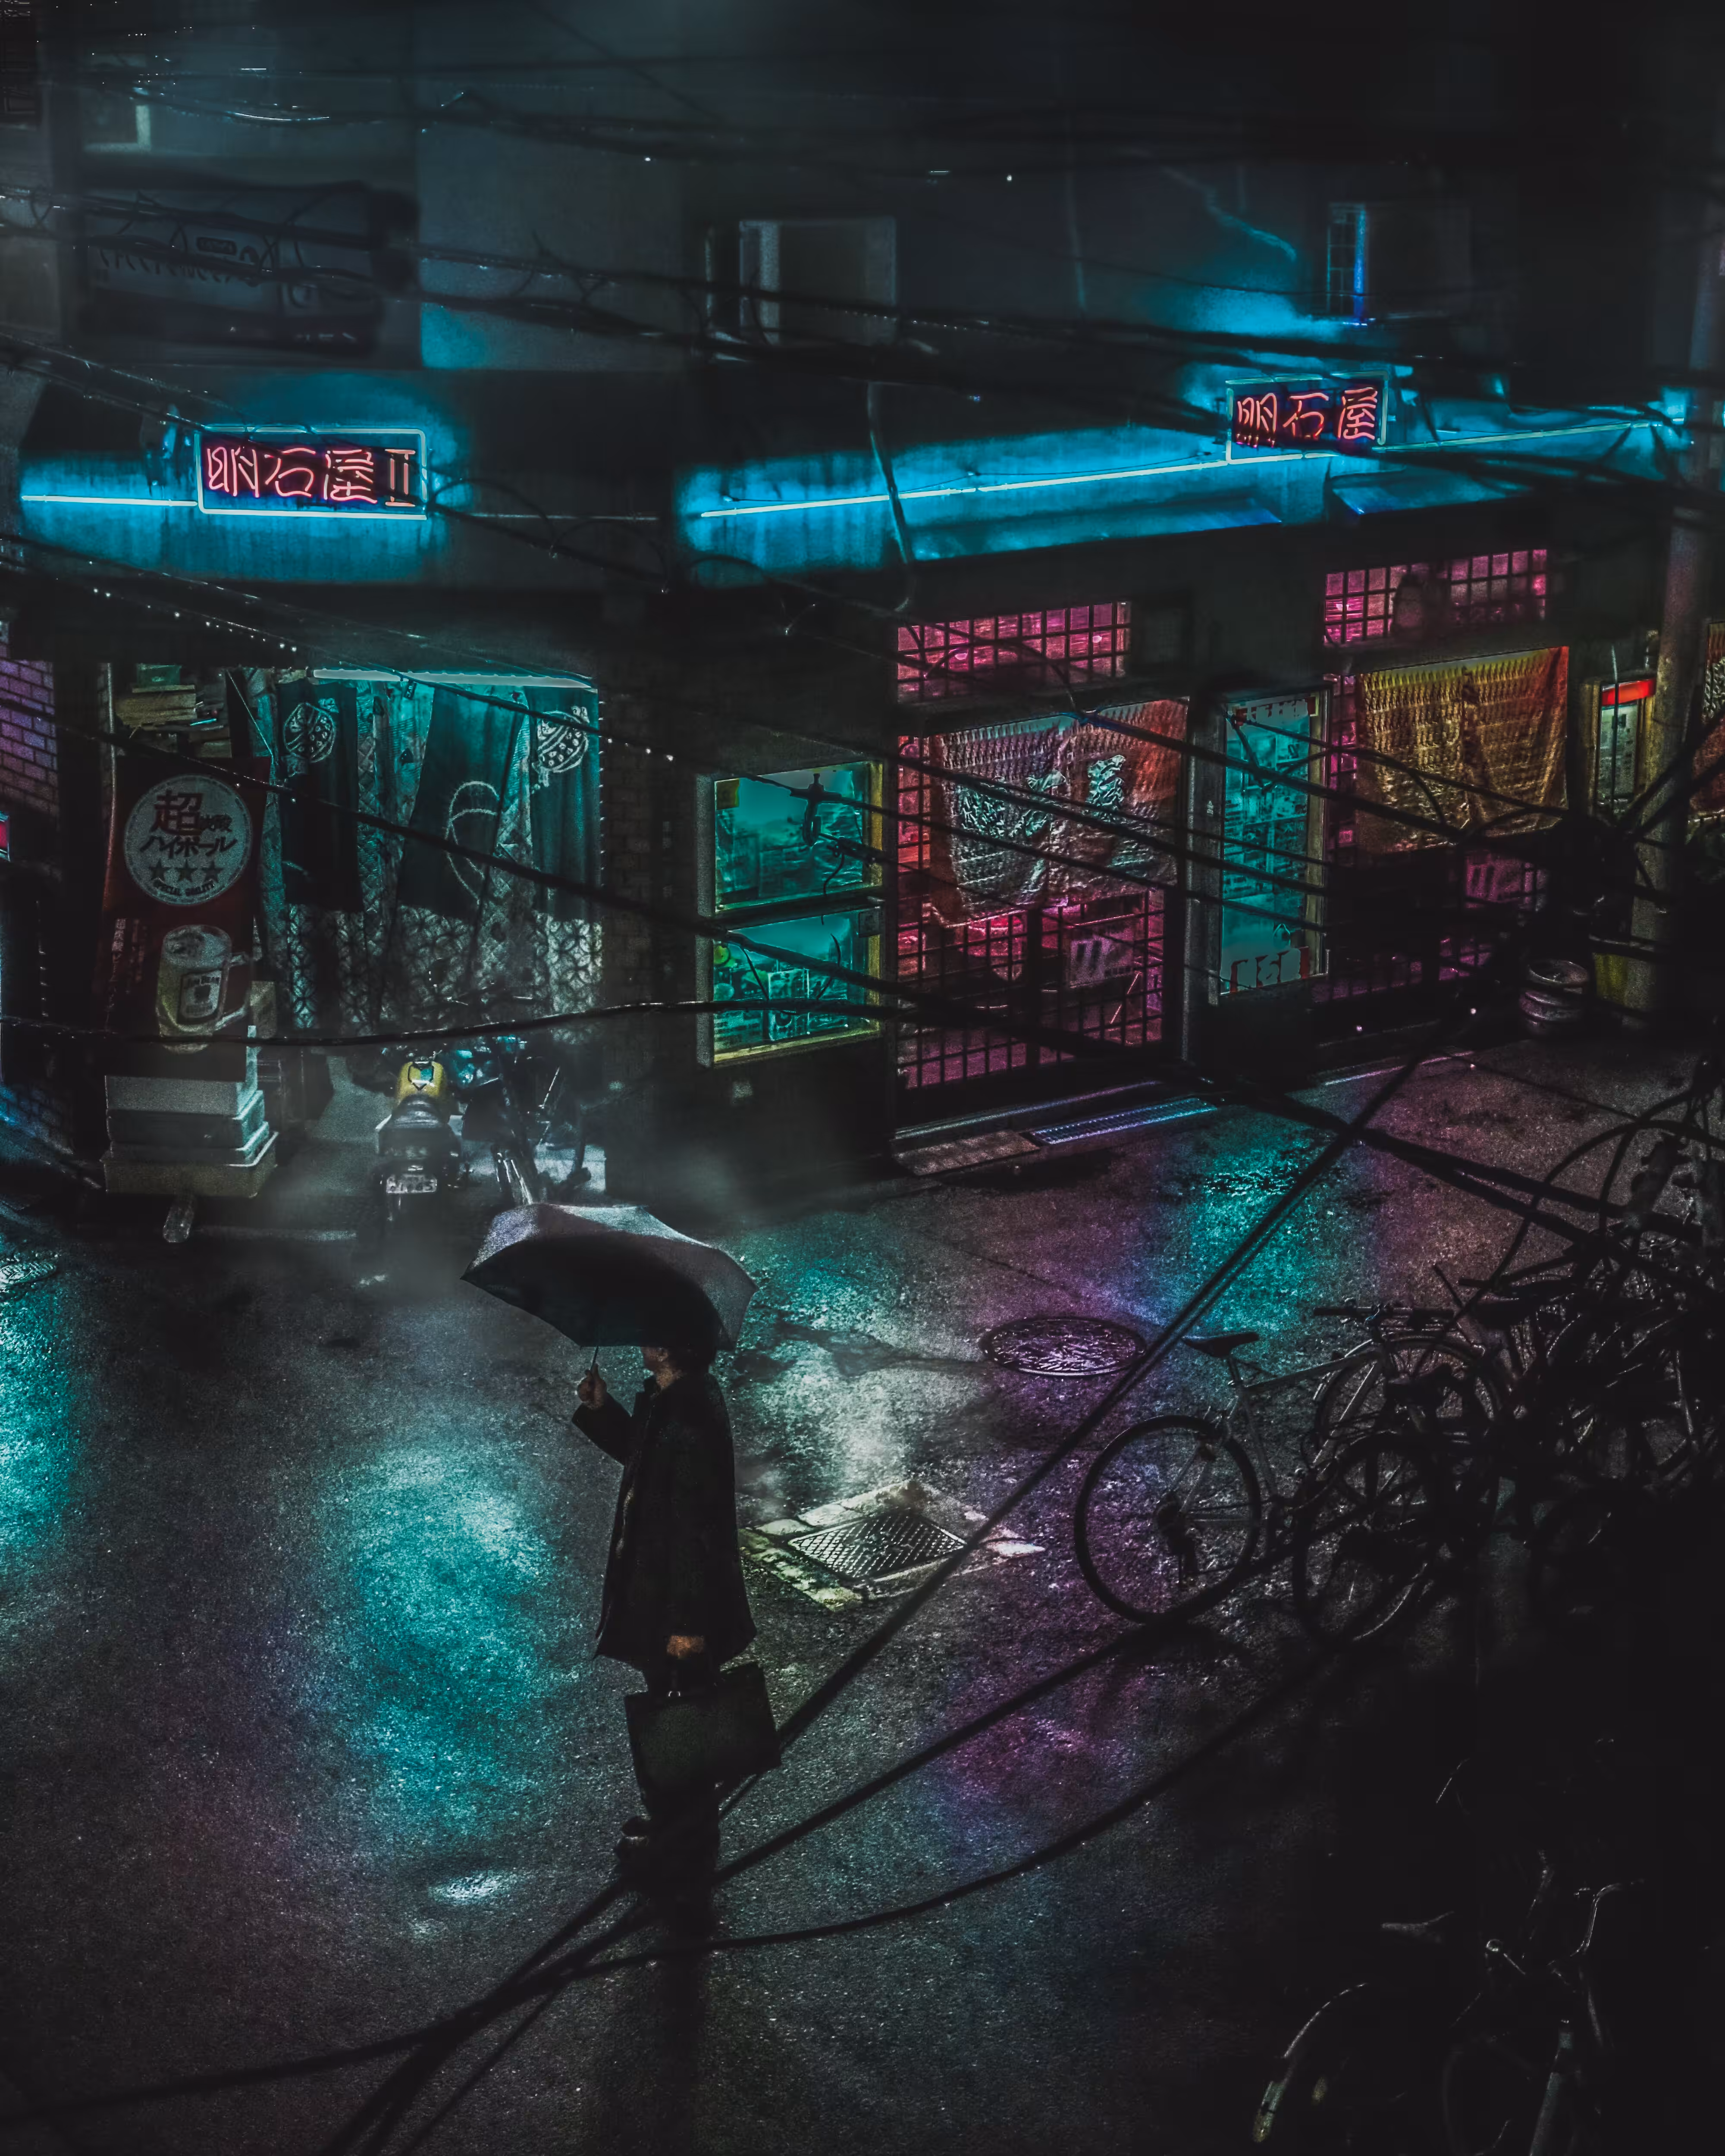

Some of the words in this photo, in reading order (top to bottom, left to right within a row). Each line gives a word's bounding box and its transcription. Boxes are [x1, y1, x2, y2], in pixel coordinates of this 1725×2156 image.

[1236, 386, 1378, 448] 明石屋
[139, 836, 238, 859] ハイボール
